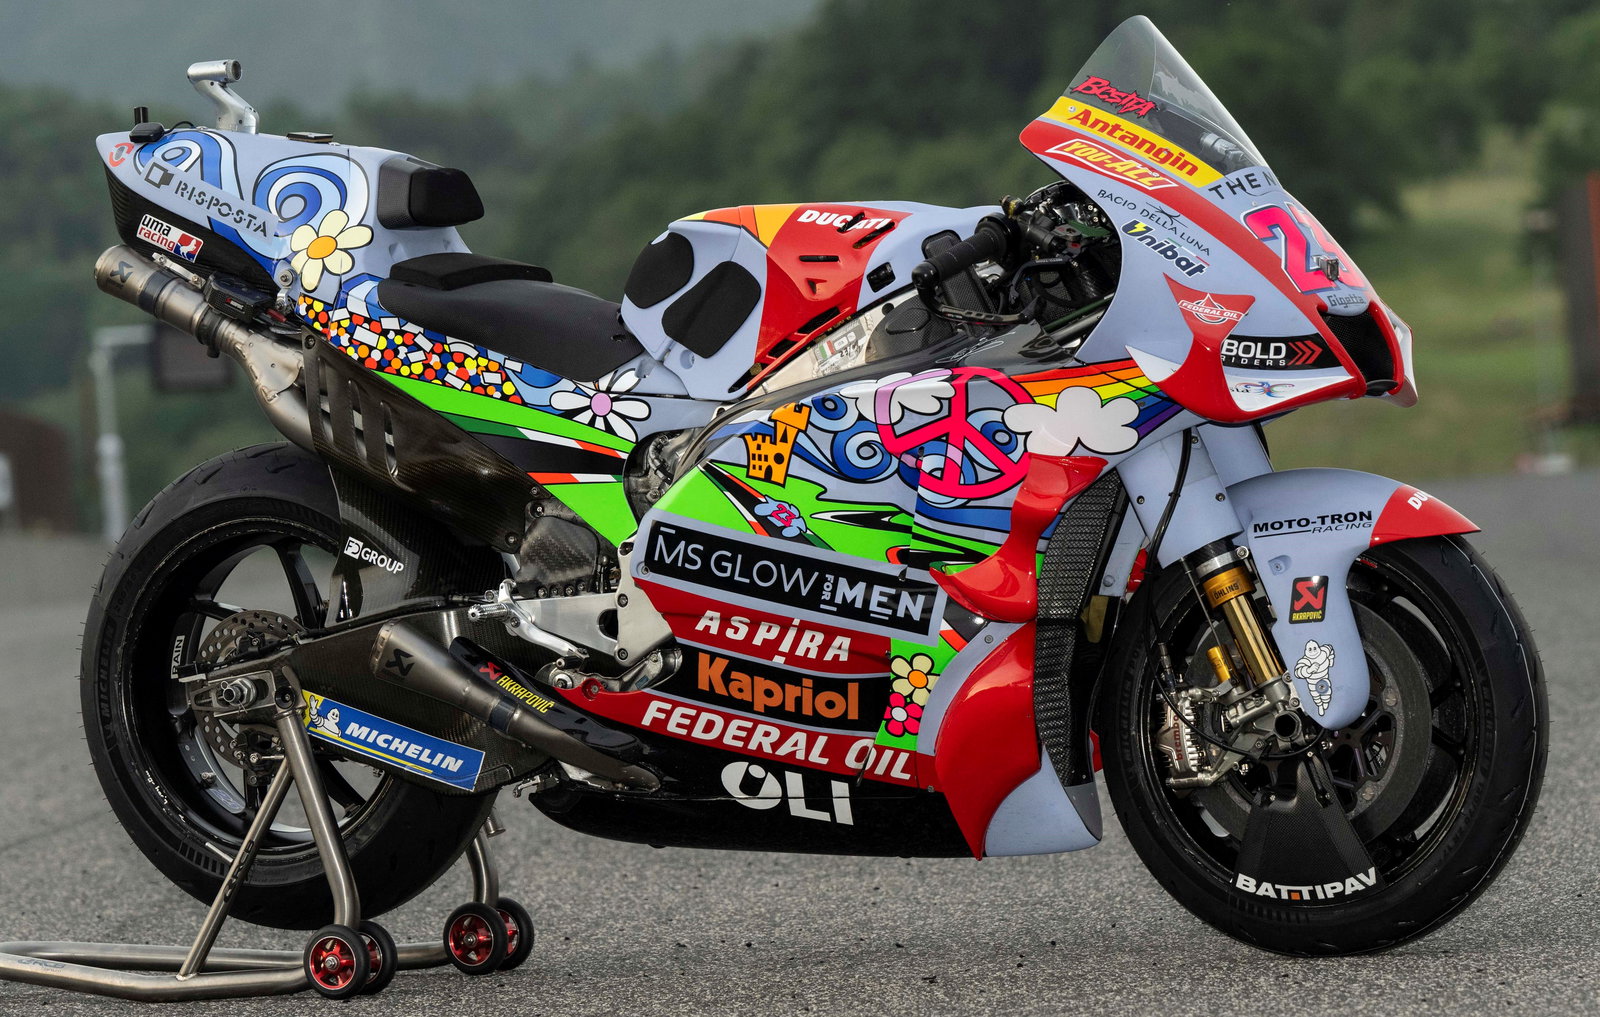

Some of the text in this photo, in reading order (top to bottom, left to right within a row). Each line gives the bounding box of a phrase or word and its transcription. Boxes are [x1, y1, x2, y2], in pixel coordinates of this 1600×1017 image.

[1068, 109, 1199, 177] Antangin
[1064, 142, 1160, 186] YOU-ALL
[1208, 172, 1261, 199] THE
[138, 227, 175, 251] racing
[141, 215, 172, 236] uma
[797, 209, 892, 231] DUCATI
[1098, 189, 1210, 256] BACIO DELLA LUNA
[1121, 219, 1208, 279] Unibat
[1182, 302, 1221, 316] FEDERAL
[1221, 339, 1287, 359] BOLD
[770, 503, 797, 527] 23
[1253, 511, 1373, 532] MOTO-TRON
[1311, 521, 1373, 534] RACING
[361, 547, 405, 574] GROUP
[654, 531, 926, 621] MS GLOW FOR MEN
[695, 610, 852, 664] ASPIRA
[697, 652, 859, 720] Kapriol
[345, 722, 465, 773] MICHELIN
[641, 700, 912, 780] FEDERAL OIL
[1173, 714, 1183, 760] brembo
[720, 761, 854, 825] OLI
[1236, 866, 1377, 900] BATTIPAV
